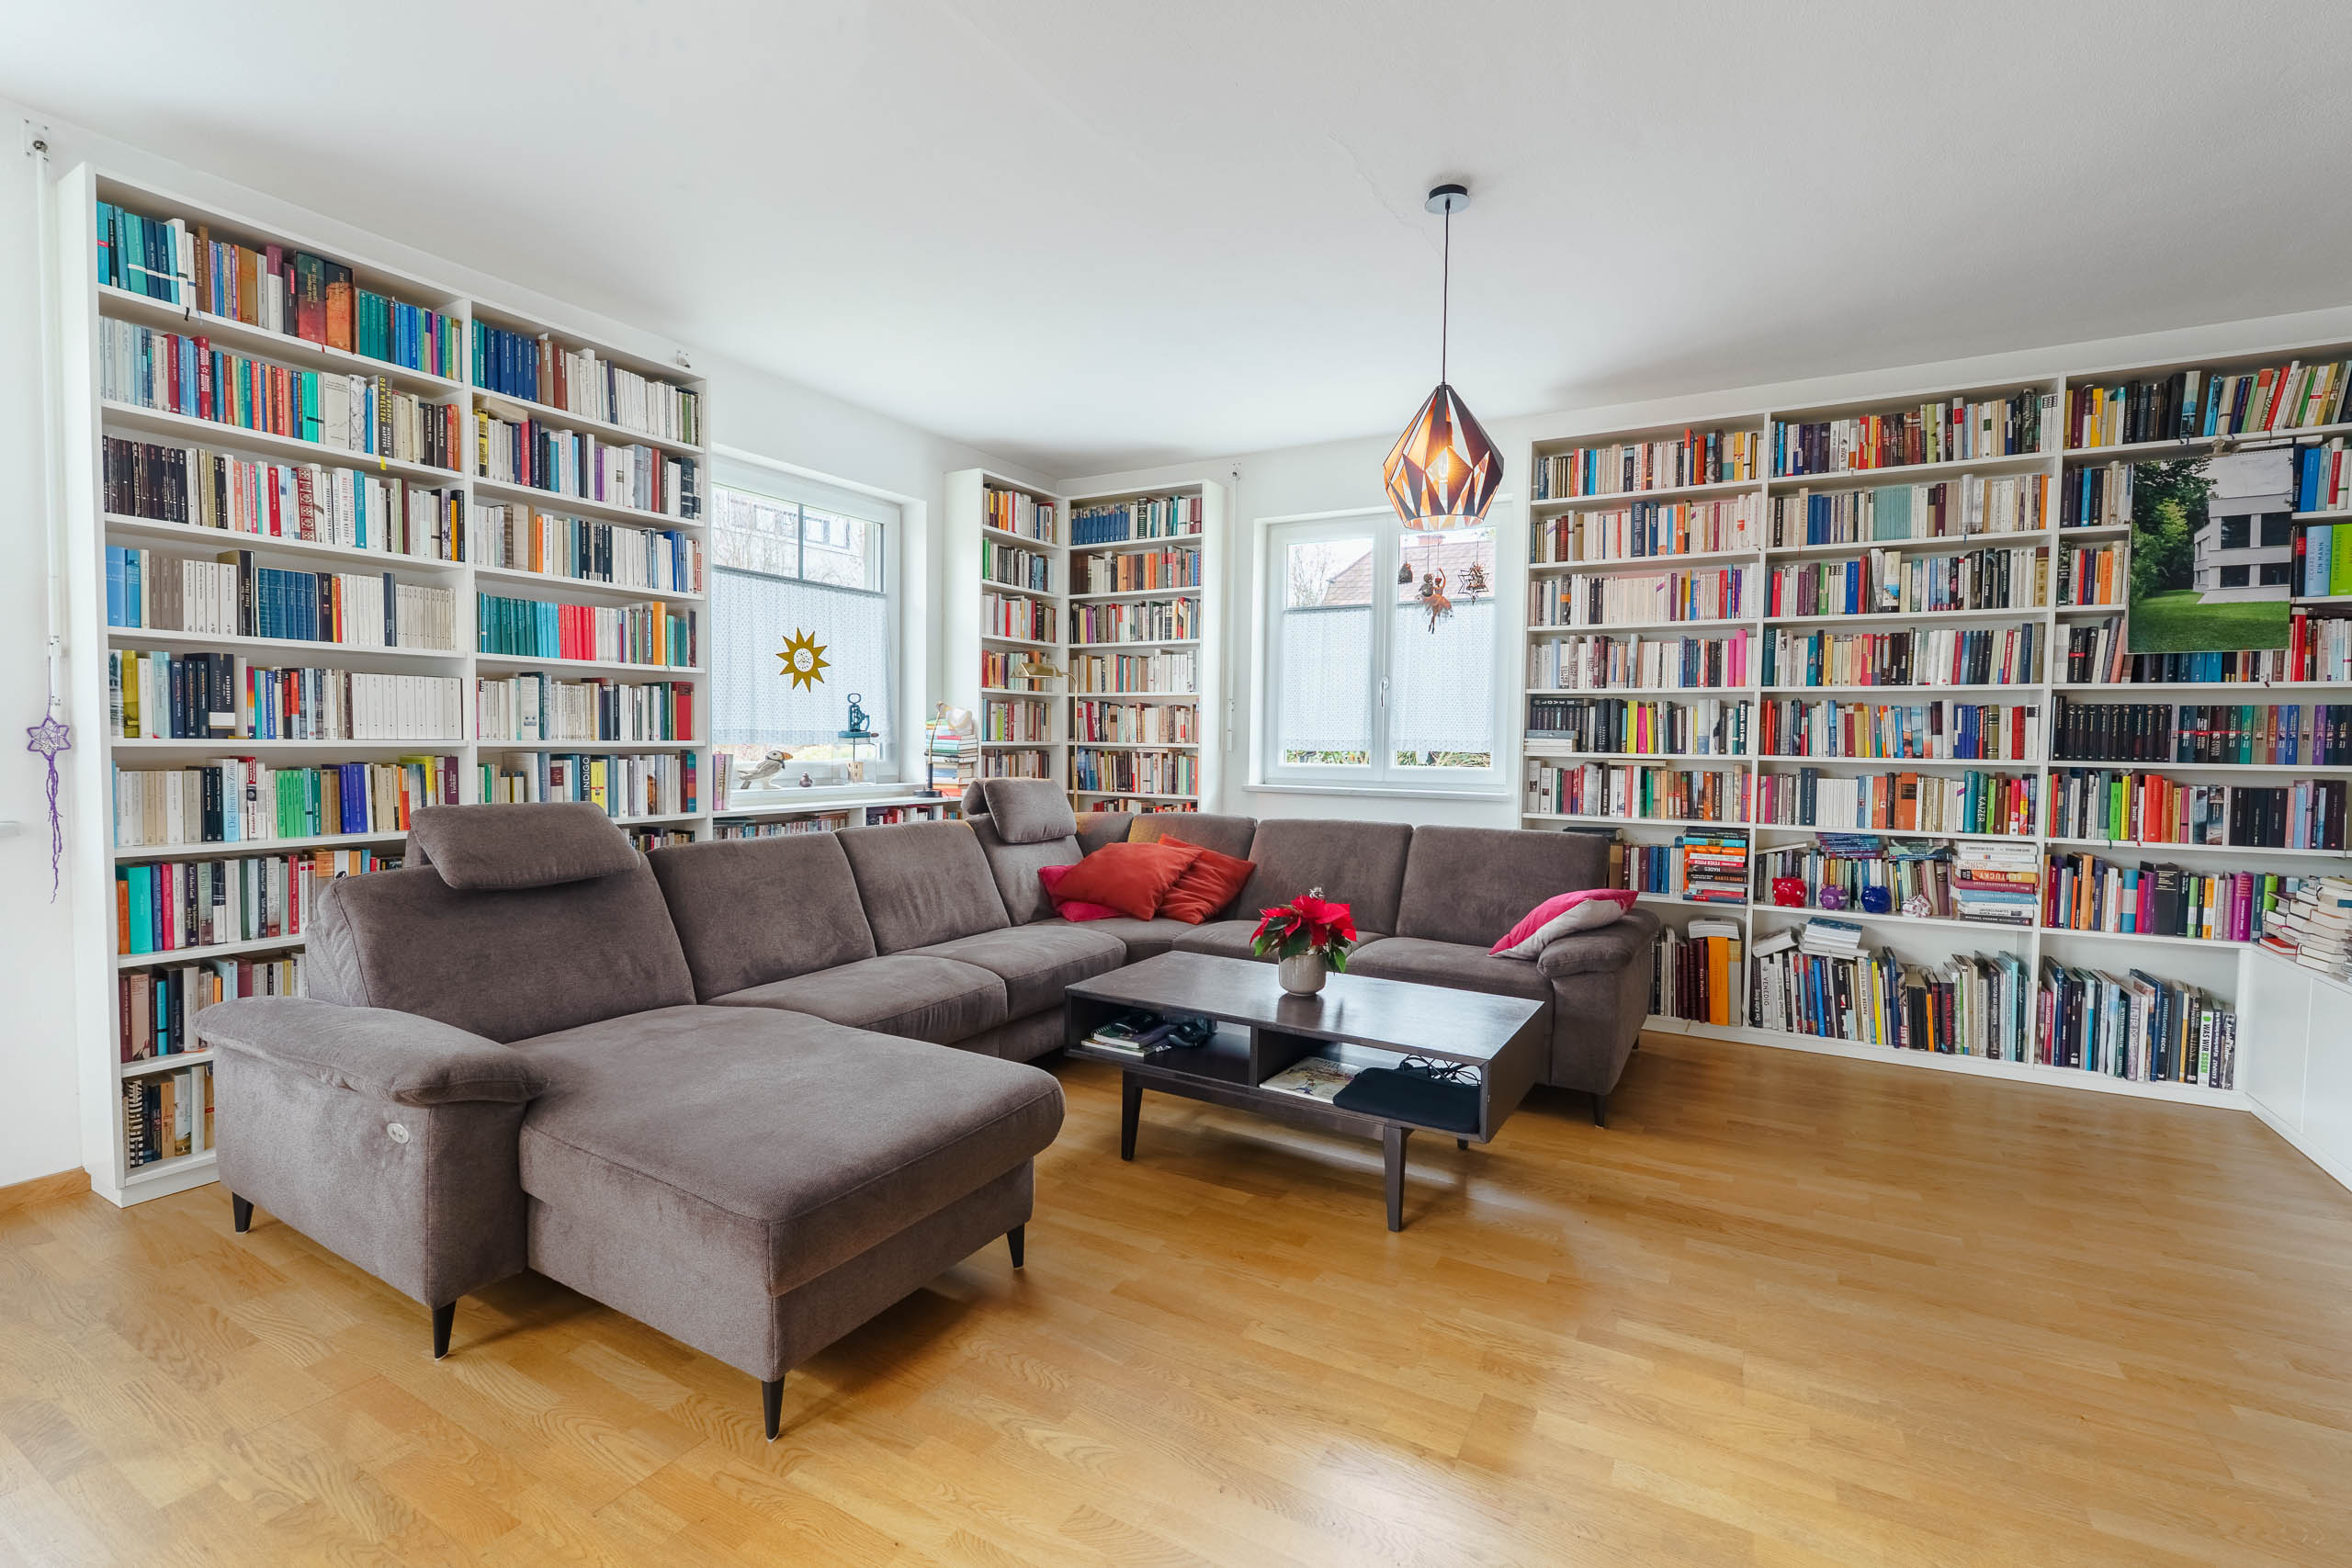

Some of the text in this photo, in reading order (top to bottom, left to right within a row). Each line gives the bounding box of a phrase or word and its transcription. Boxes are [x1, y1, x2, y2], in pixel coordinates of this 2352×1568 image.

[386, 388, 392, 397] IM
[1634, 502, 1643, 520] HITCH
[227, 765, 235, 782] Zion
[227, 796, 235, 813] Irren
[227, 815, 235, 828] Die
[1979, 873, 2021, 881] KENTUCKY
[2131, 1009, 2139, 1026] PETER
[2200, 1024, 2211, 1073] WAS WIR ESSEN
